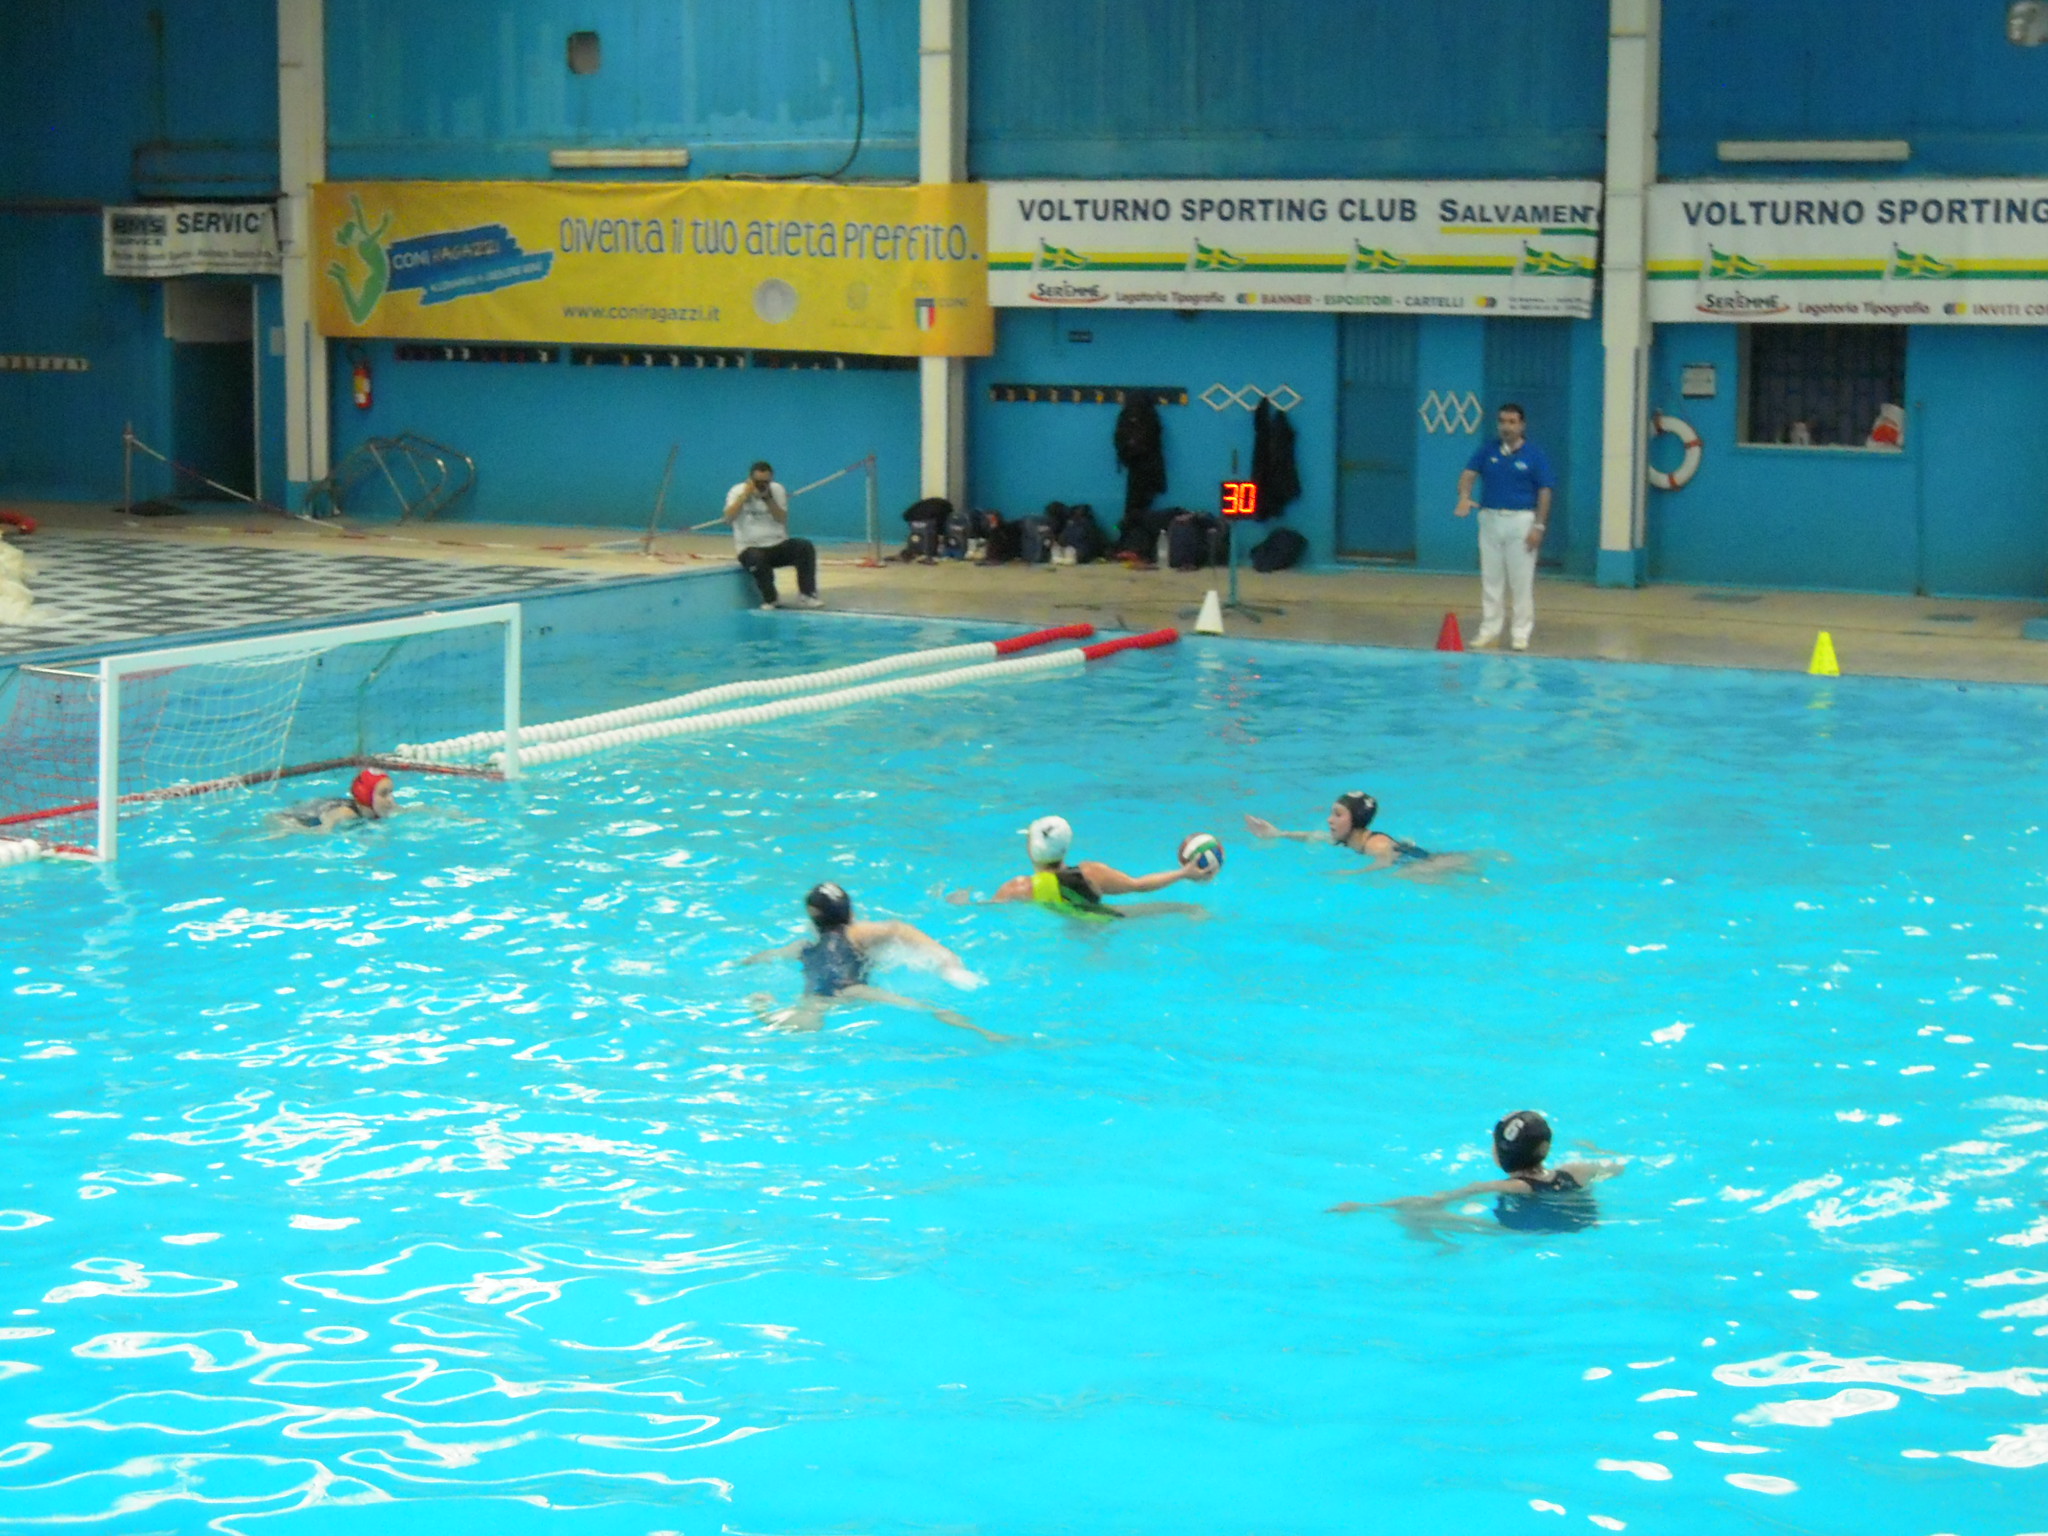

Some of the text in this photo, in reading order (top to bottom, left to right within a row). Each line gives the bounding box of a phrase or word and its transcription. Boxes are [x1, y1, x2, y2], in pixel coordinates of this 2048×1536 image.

[1019, 198, 1170, 222] VOLTURNO
[1181, 198, 1328, 222] SPORTING
[1338, 198, 1417, 222] CLUB
[1682, 198, 2048, 225] VOLTURNO SPORTING
[176, 212, 266, 234] SERVIC
[691, 218, 739, 255] tuo
[392, 250, 430, 270] CONI
[1261, 295, 1312, 305] BANNER
[1405, 296, 1464, 307] CARTELLI
[1973, 304, 2048, 315] INVITI CO
[1222, 482, 1257, 514] 30
